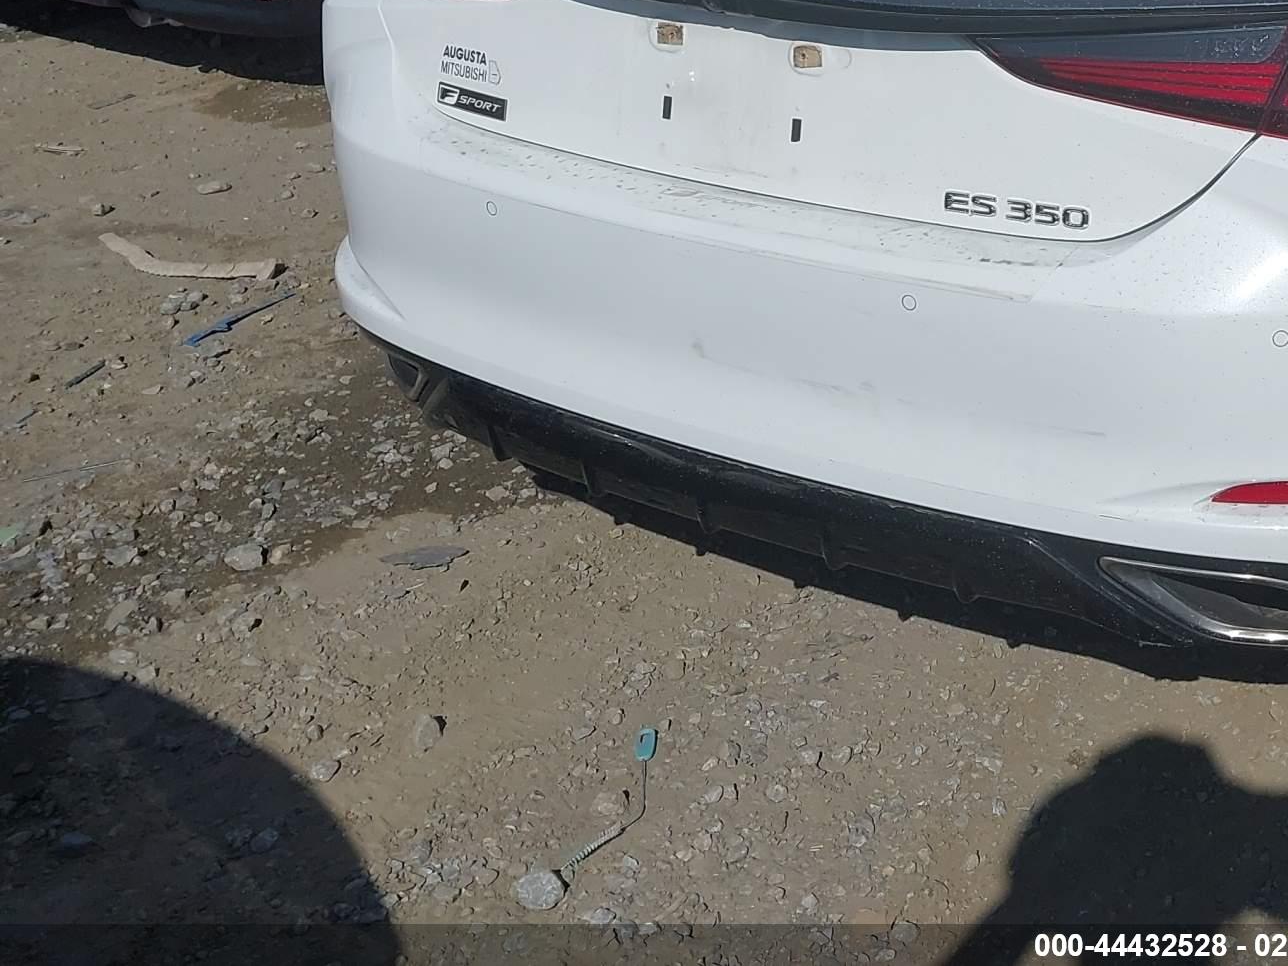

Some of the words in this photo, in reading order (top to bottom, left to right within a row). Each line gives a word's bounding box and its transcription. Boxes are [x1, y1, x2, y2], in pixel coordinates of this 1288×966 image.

[442, 44, 487, 66] AUGUSTA
[440, 60, 488, 83] MITSUBISHI
[458, 95, 501, 113] SPORT
[944, 191, 997, 217] ES
[1005, 197, 1090, 230] 350
